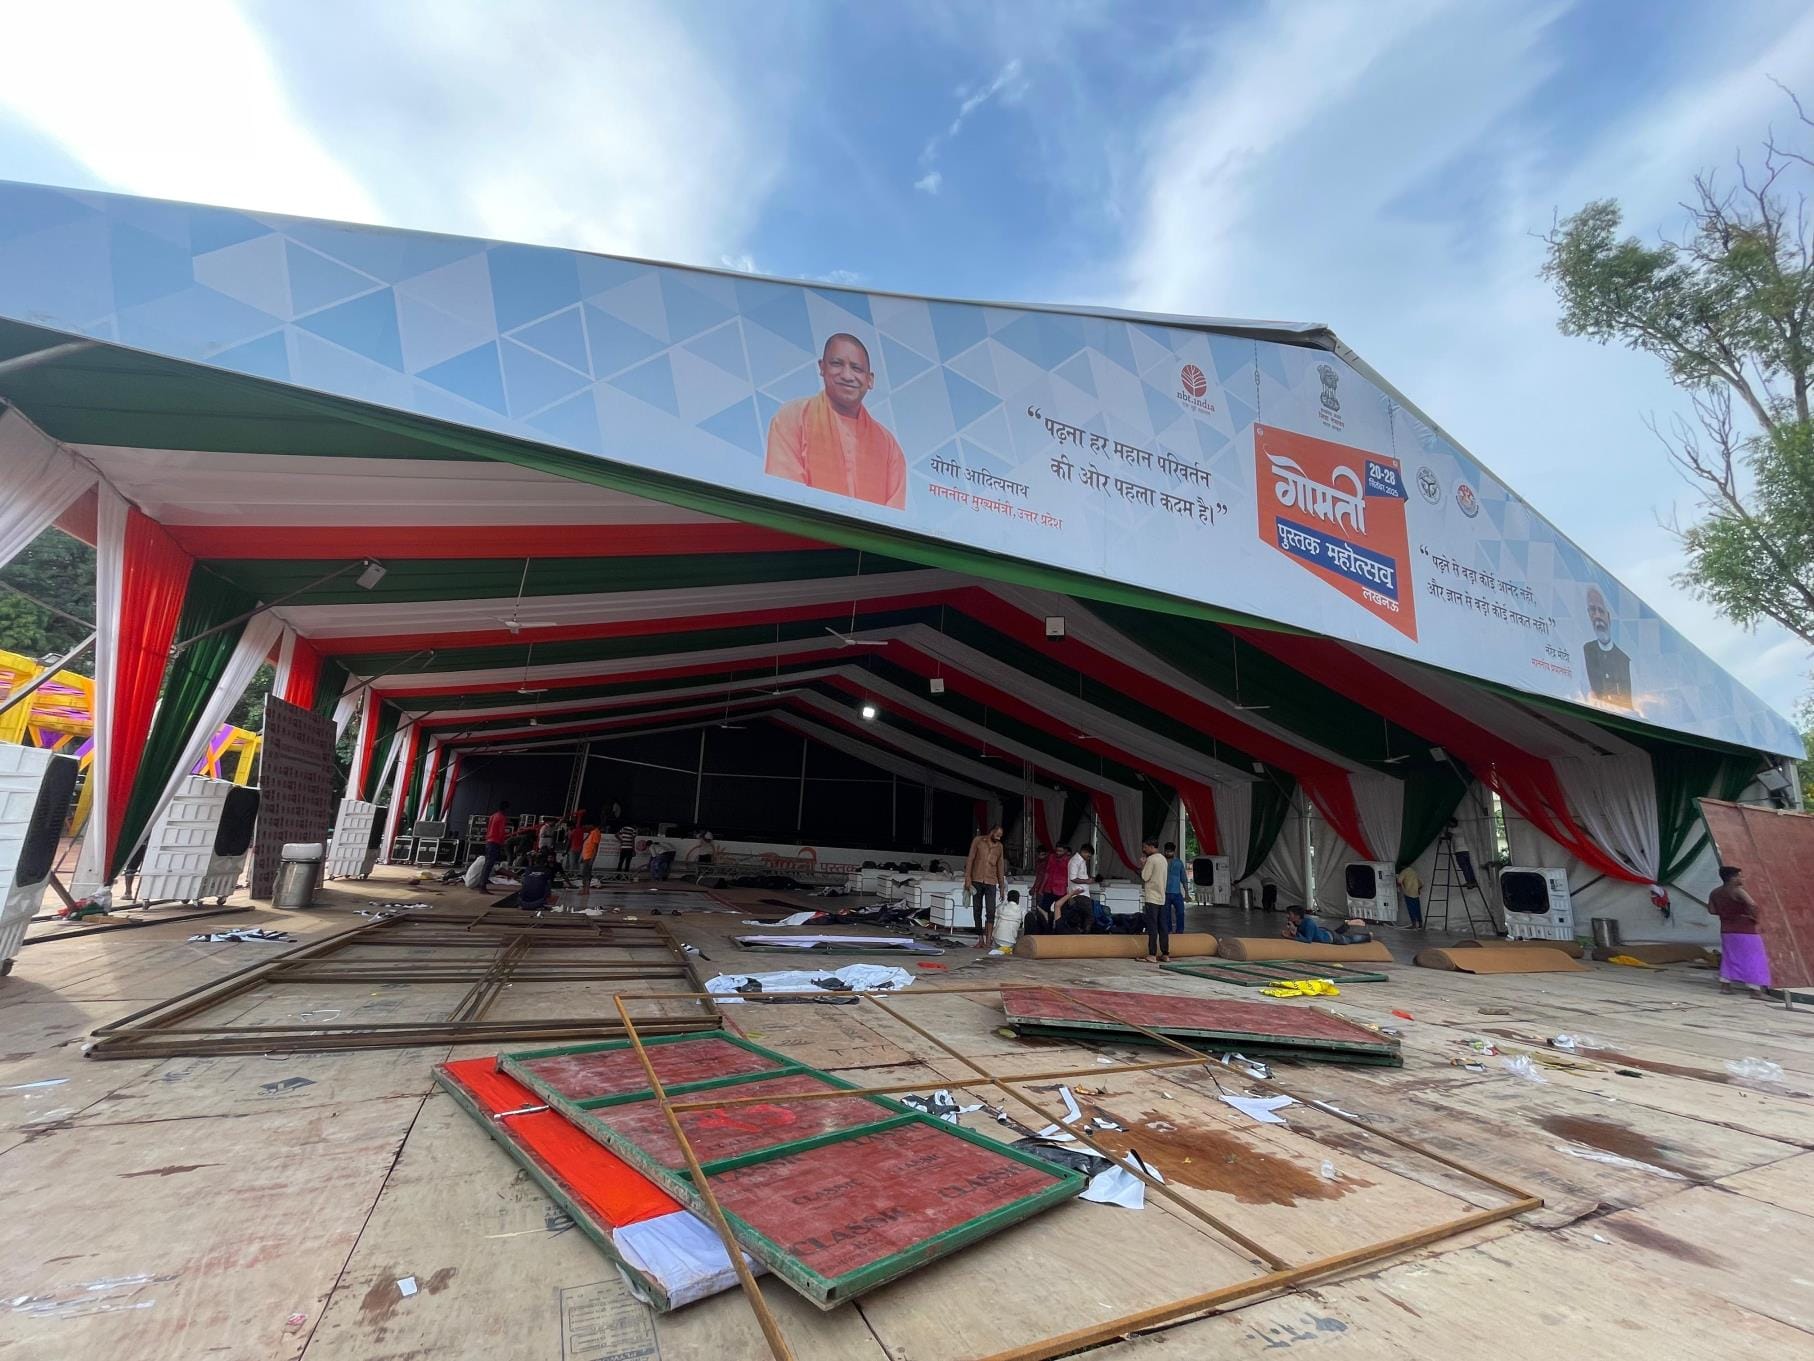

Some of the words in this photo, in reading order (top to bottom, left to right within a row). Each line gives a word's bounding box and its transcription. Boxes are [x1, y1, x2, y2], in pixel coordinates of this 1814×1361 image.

[1177, 391, 1215, 412] nbt.india
[930, 454, 961, 479] योगी
[964, 468, 1030, 499] आदित्यनाथ
[1090, 432, 1110, 460] हर
[1113, 440, 1154, 468] महान
[1157, 452, 1212, 489] परिवर्तन
[1369, 462, 1396, 486] 20-28
[928, 483, 969, 505] माननीय
[1041, 511, 1063, 530] प्रदेश
[1050, 454, 1074, 482] की
[1078, 461, 1111, 498] ओर
[1114, 477, 1157, 506] पहला
[1159, 491, 1196, 518] कदम
[1263, 445, 1367, 539] गोमती
[1277, 523, 1321, 555] पुस्तक
[1325, 542, 1395, 590] महोत्सव
[1361, 586, 1400, 613] लखनऊ
